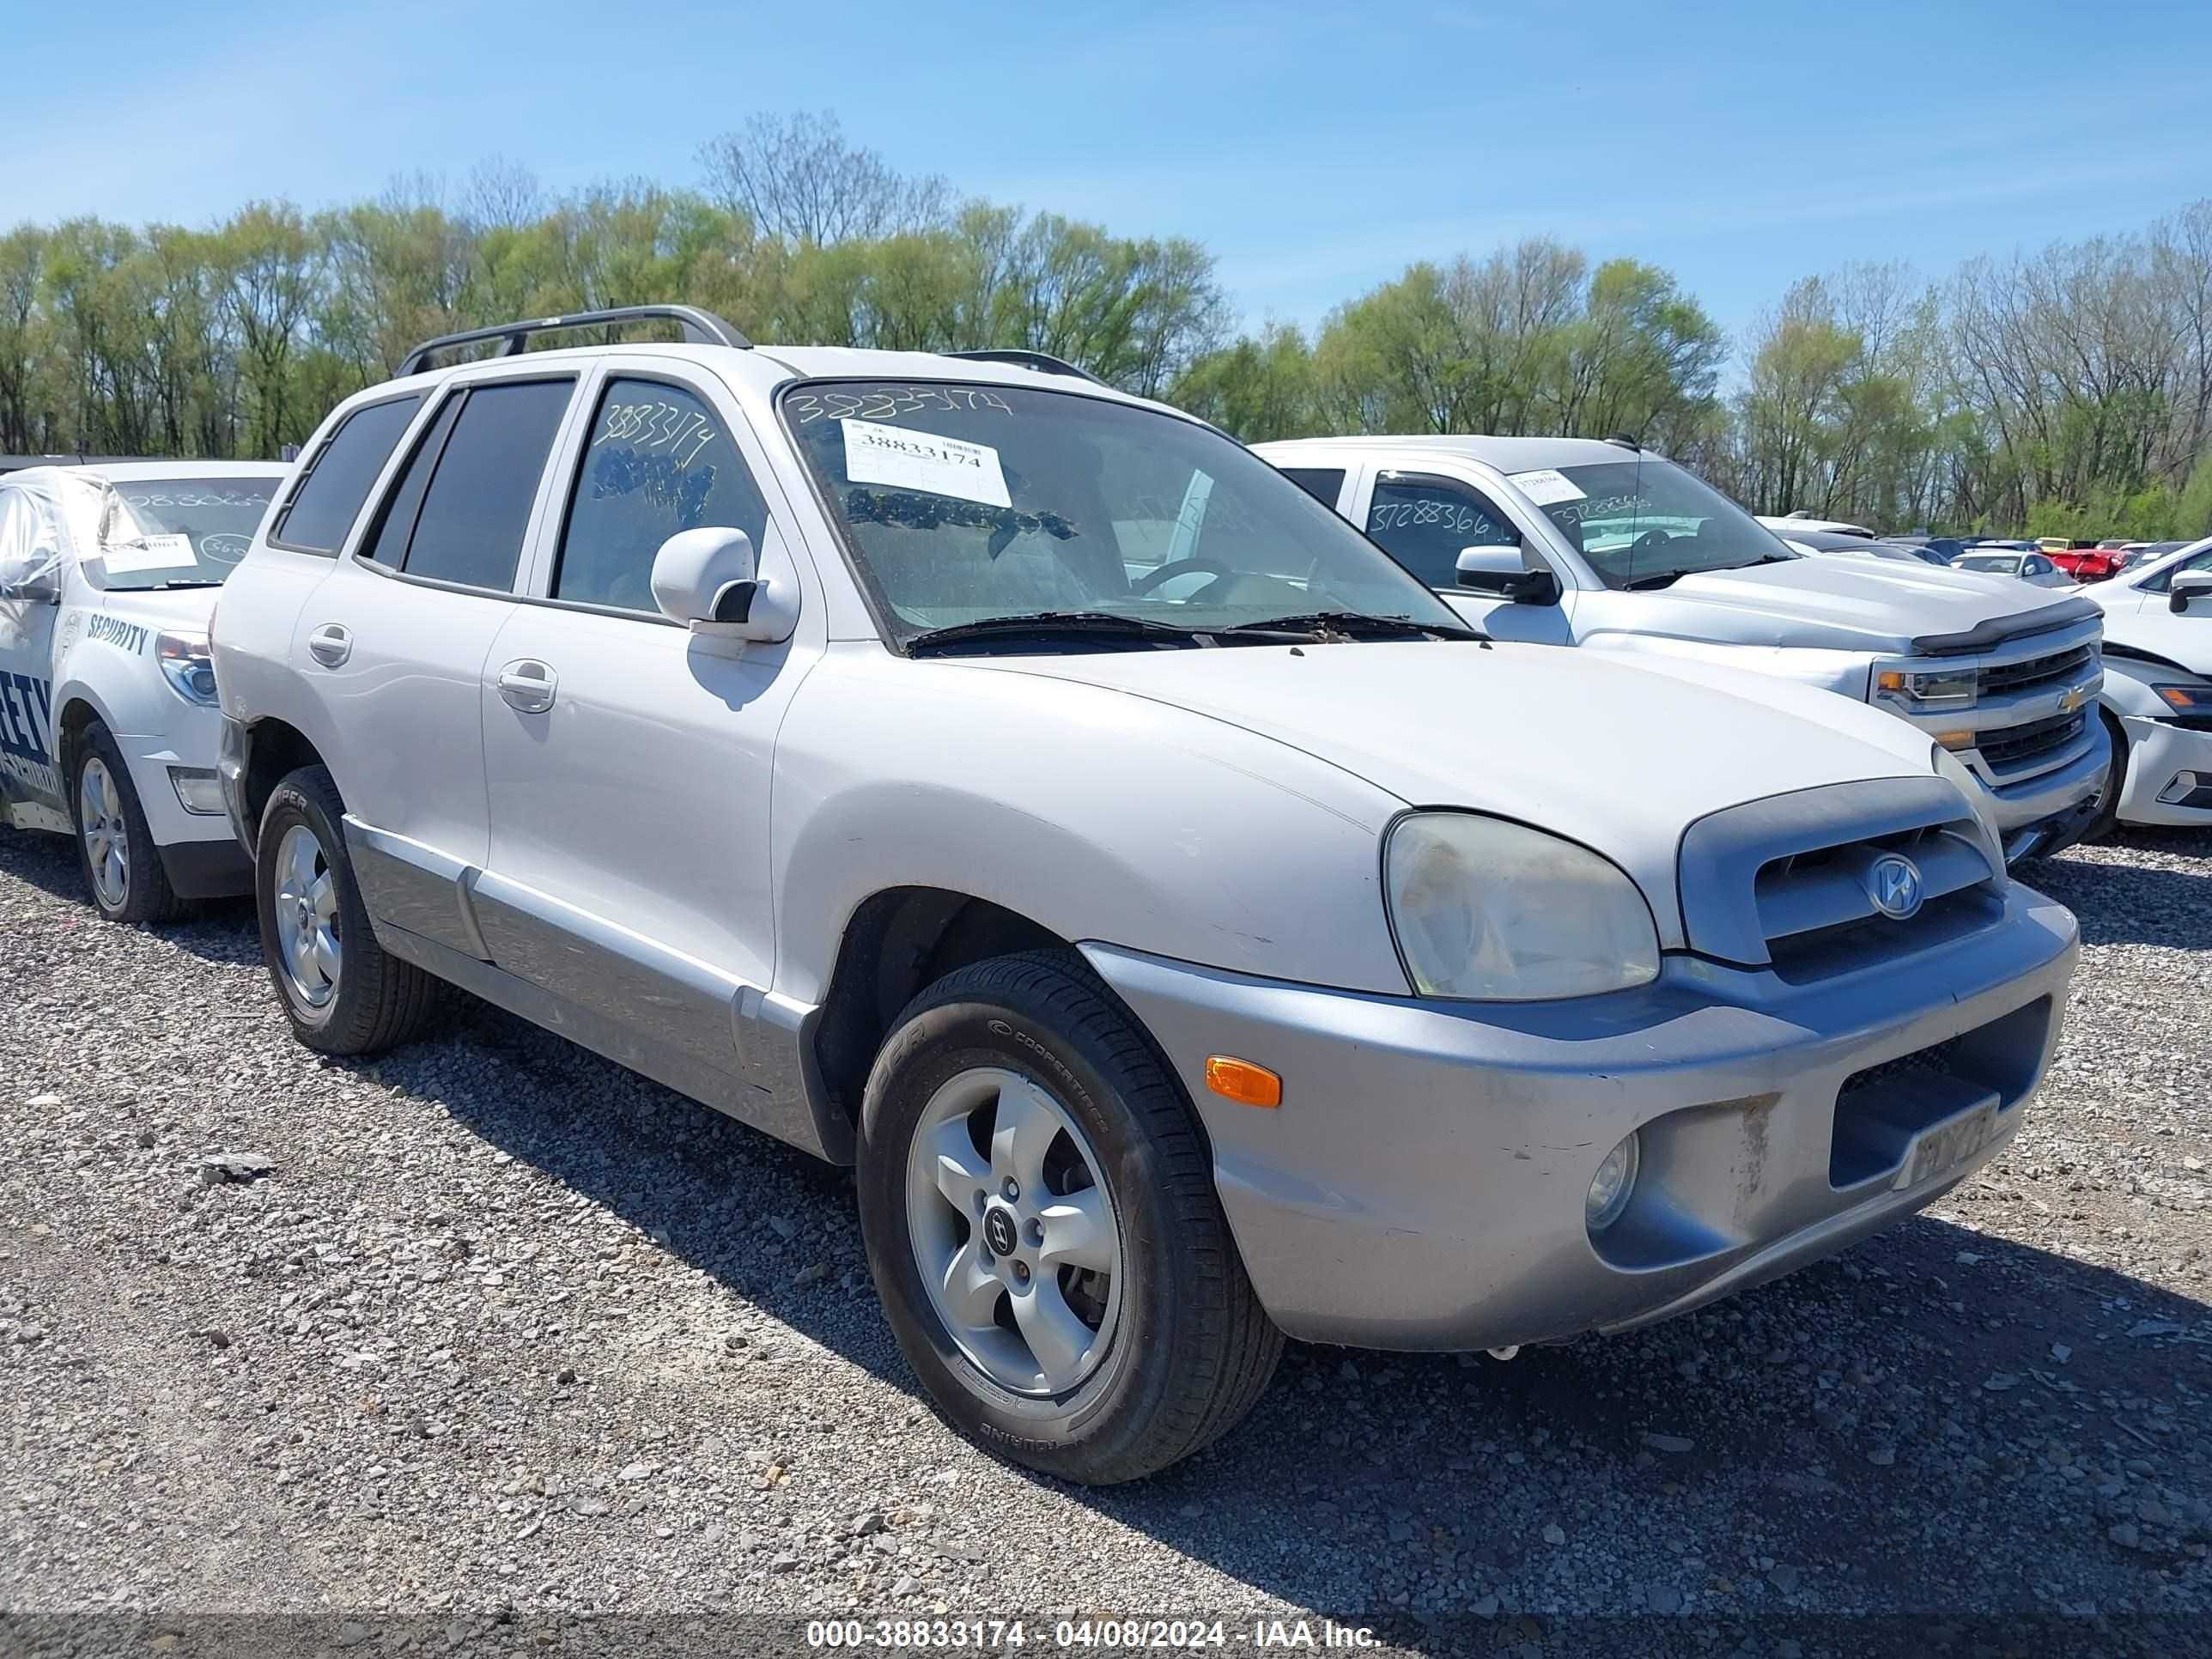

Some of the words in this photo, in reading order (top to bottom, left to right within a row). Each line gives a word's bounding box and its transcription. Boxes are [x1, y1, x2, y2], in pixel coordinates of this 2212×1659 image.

[593, 402, 715, 468] 38833174
[861, 434, 981, 468] 38833174
[1370, 500, 1489, 536] 37288366
[88, 614, 149, 655] SECURITY
